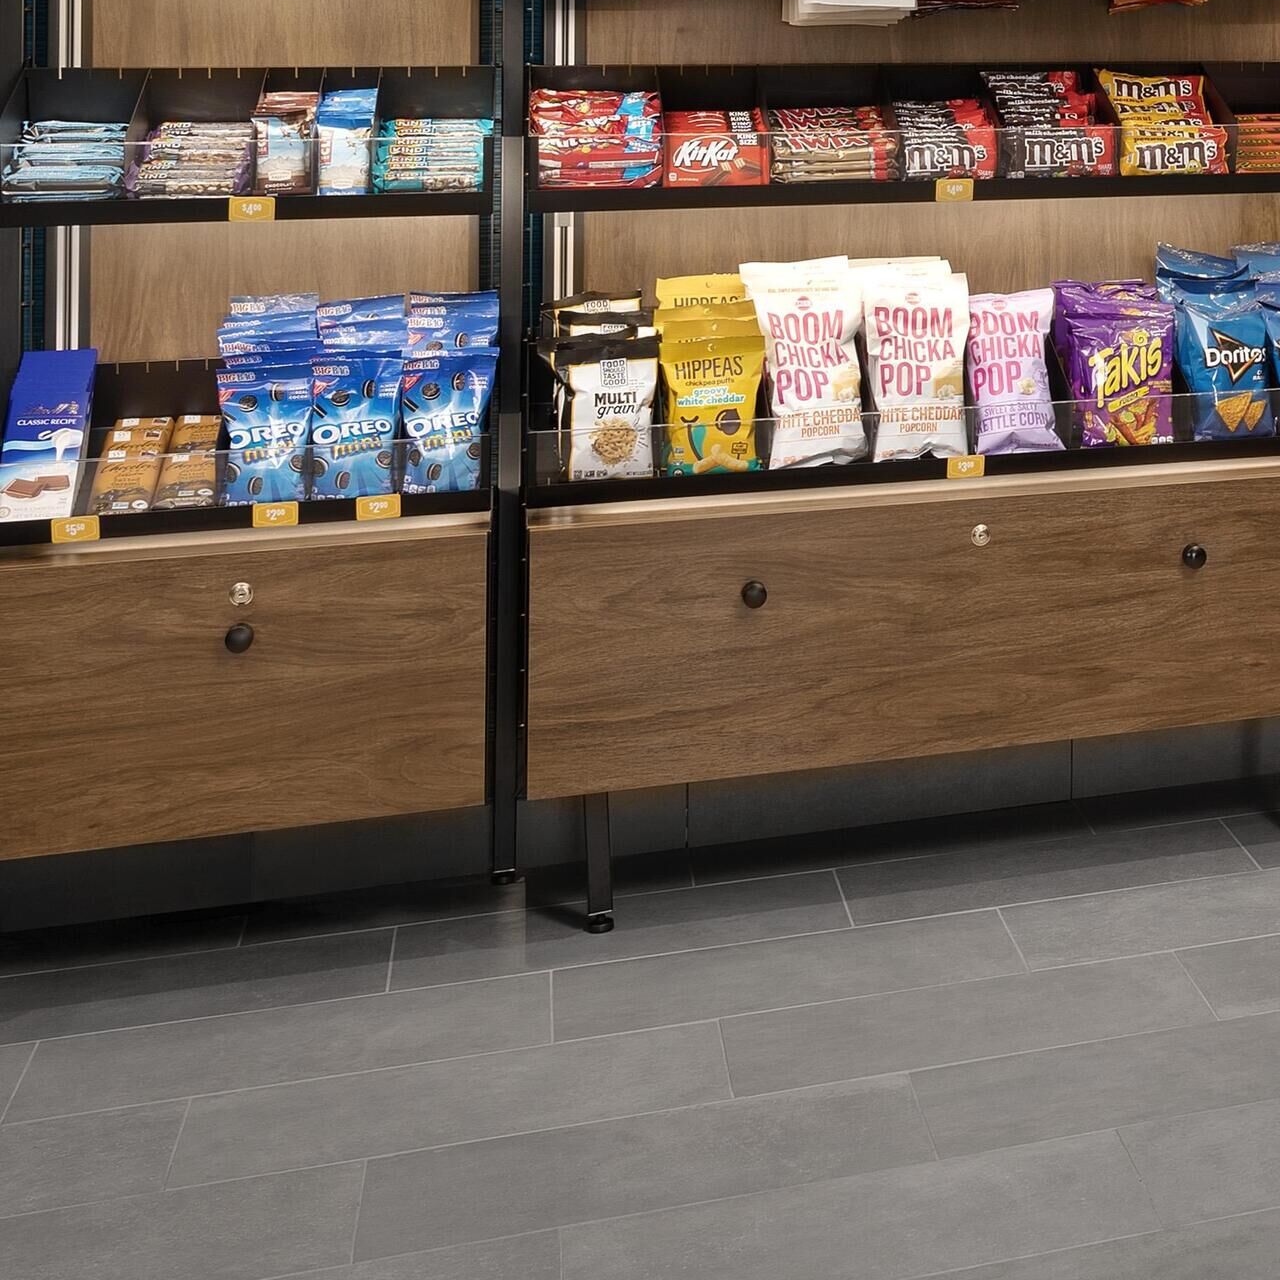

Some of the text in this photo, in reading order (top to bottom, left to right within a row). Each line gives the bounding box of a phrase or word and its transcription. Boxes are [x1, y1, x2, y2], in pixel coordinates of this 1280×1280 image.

[785, 136, 869, 152] TWIX
[767, 310, 844, 345] BOOM
[874, 307, 953, 338] BOOM
[775, 342, 849, 368] CHICKA
[879, 337, 956, 362] CHICKA
[970, 334, 1042, 365] CHICKA
[333, 367, 349, 375] BAG
[602, 360, 625, 368] FOOD
[675, 356, 743, 380] HIPPEAS
[1089, 334, 1162, 409] Takis
[235, 372, 255, 381] BAG
[717, 377, 734, 386] puffs
[776, 369, 829, 404] POP
[880, 362, 931, 398] POP
[974, 361, 1022, 401] POP
[594, 392, 636, 407] MULTI
[677, 394, 744, 406] white cheddar
[694, 387, 728, 397] groovy
[597, 405, 635, 419] grain
[985, 407, 1007, 417] SWEET
[1017, 403, 1038, 412] SALTY
[230, 422, 305, 449] OREO
[313, 420, 391, 444] OREO
[406, 412, 479, 438] OREO
[802, 425, 840, 437] POPCORN
[899, 422, 937, 433] POPCORN
